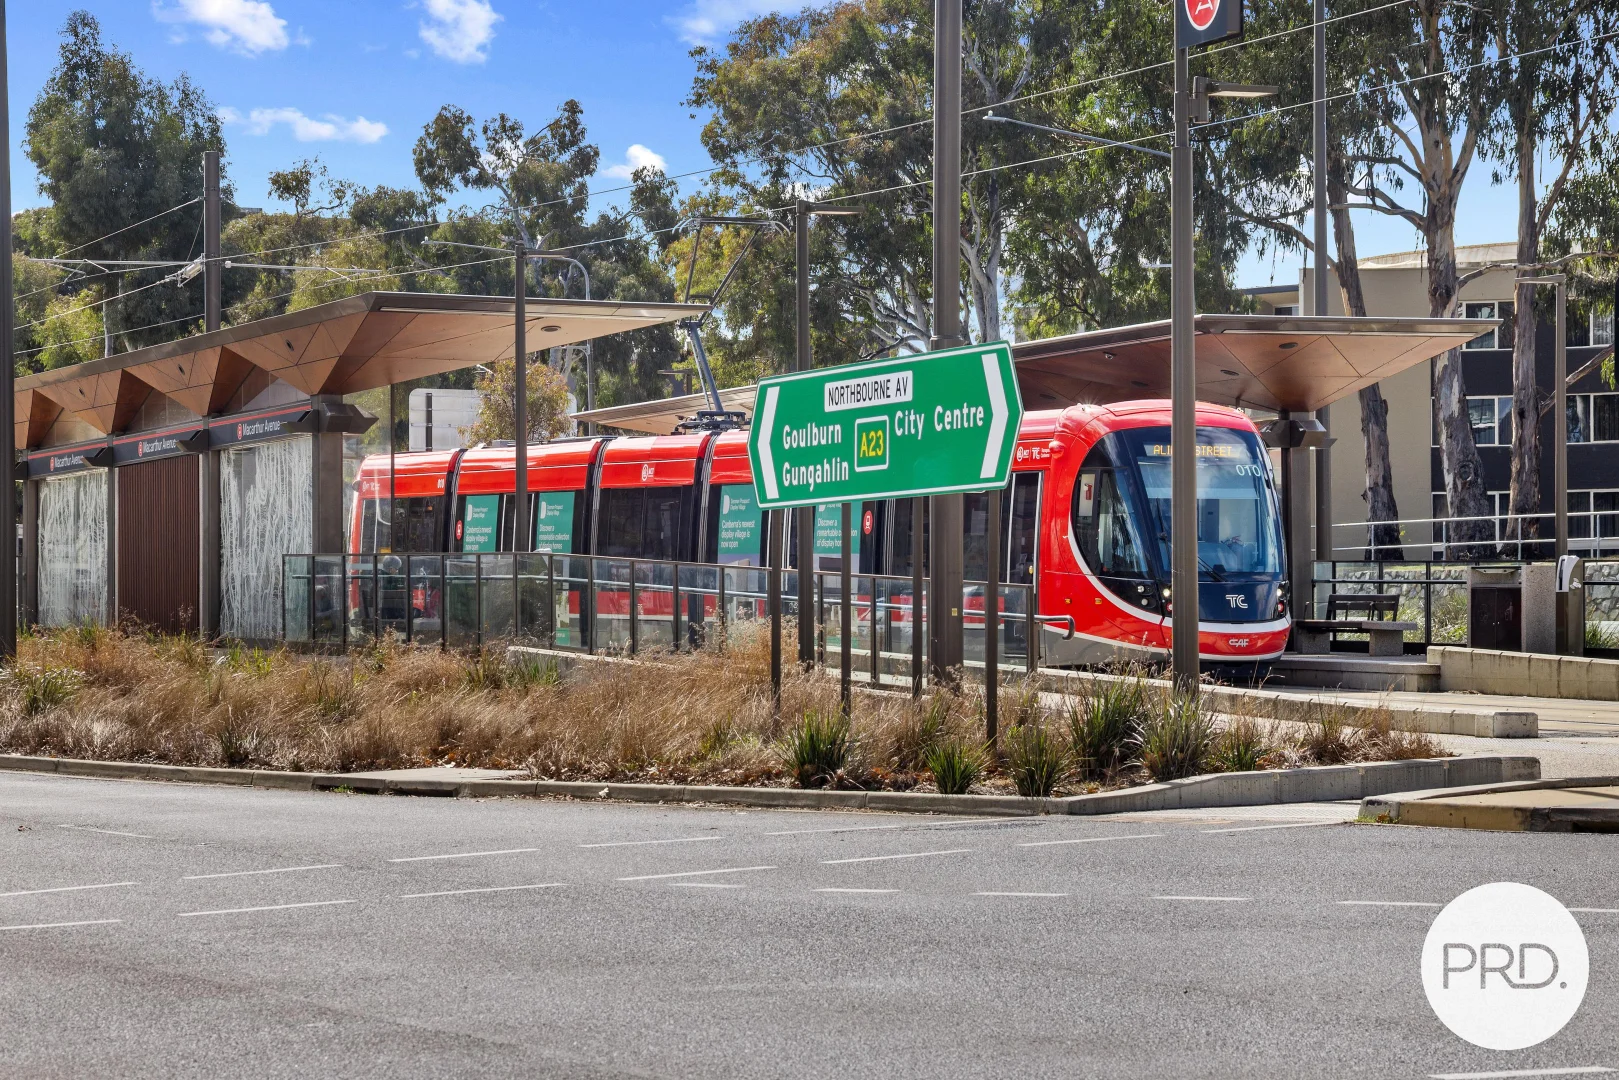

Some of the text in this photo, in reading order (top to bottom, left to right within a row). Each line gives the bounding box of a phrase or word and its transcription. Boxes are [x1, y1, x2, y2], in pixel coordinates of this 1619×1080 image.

[828, 376, 909, 407] NORTHBOURNE AV
[243, 419, 280, 436] Macarthur Avenue
[894, 402, 985, 440] City Centre
[782, 422, 842, 450] Goulburn
[143, 439, 162, 453] Macarthur
[859, 429, 884, 458] A23
[1195, 445, 1232, 457] STREET
[782, 457, 849, 492] Gungahlin
[1236, 464, 1261, 477] 010
[721, 519, 741, 529] Canberra's
[817, 517, 834, 527] Discover
[821, 538, 835, 549] display
[1225, 594, 1249, 609] TC
[1228, 637, 1250, 648] CAF
